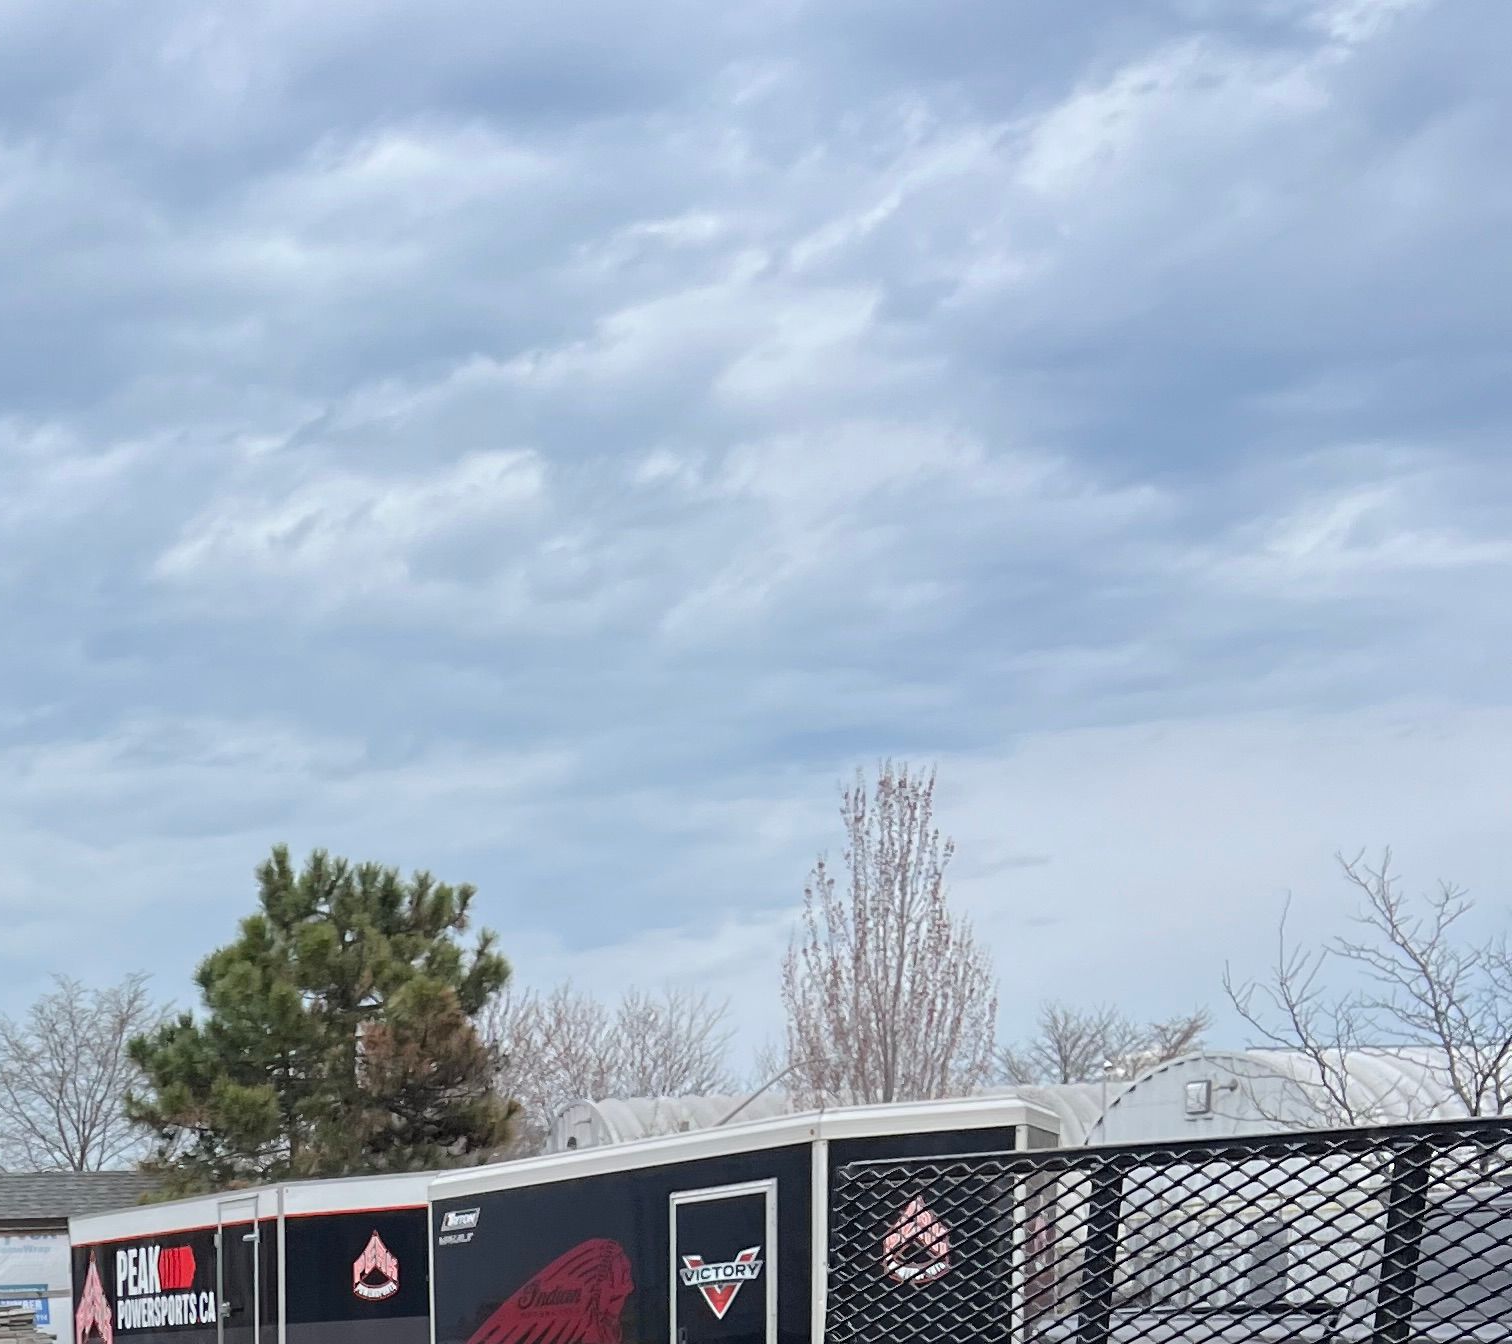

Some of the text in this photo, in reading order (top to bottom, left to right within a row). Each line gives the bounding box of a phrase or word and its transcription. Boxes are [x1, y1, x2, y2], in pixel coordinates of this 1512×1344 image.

[116, 1244, 162, 1297] PEAK
[684, 1263, 759, 1282] VICTORY
[117, 1291, 216, 1330] POWERSPORTS.CA
